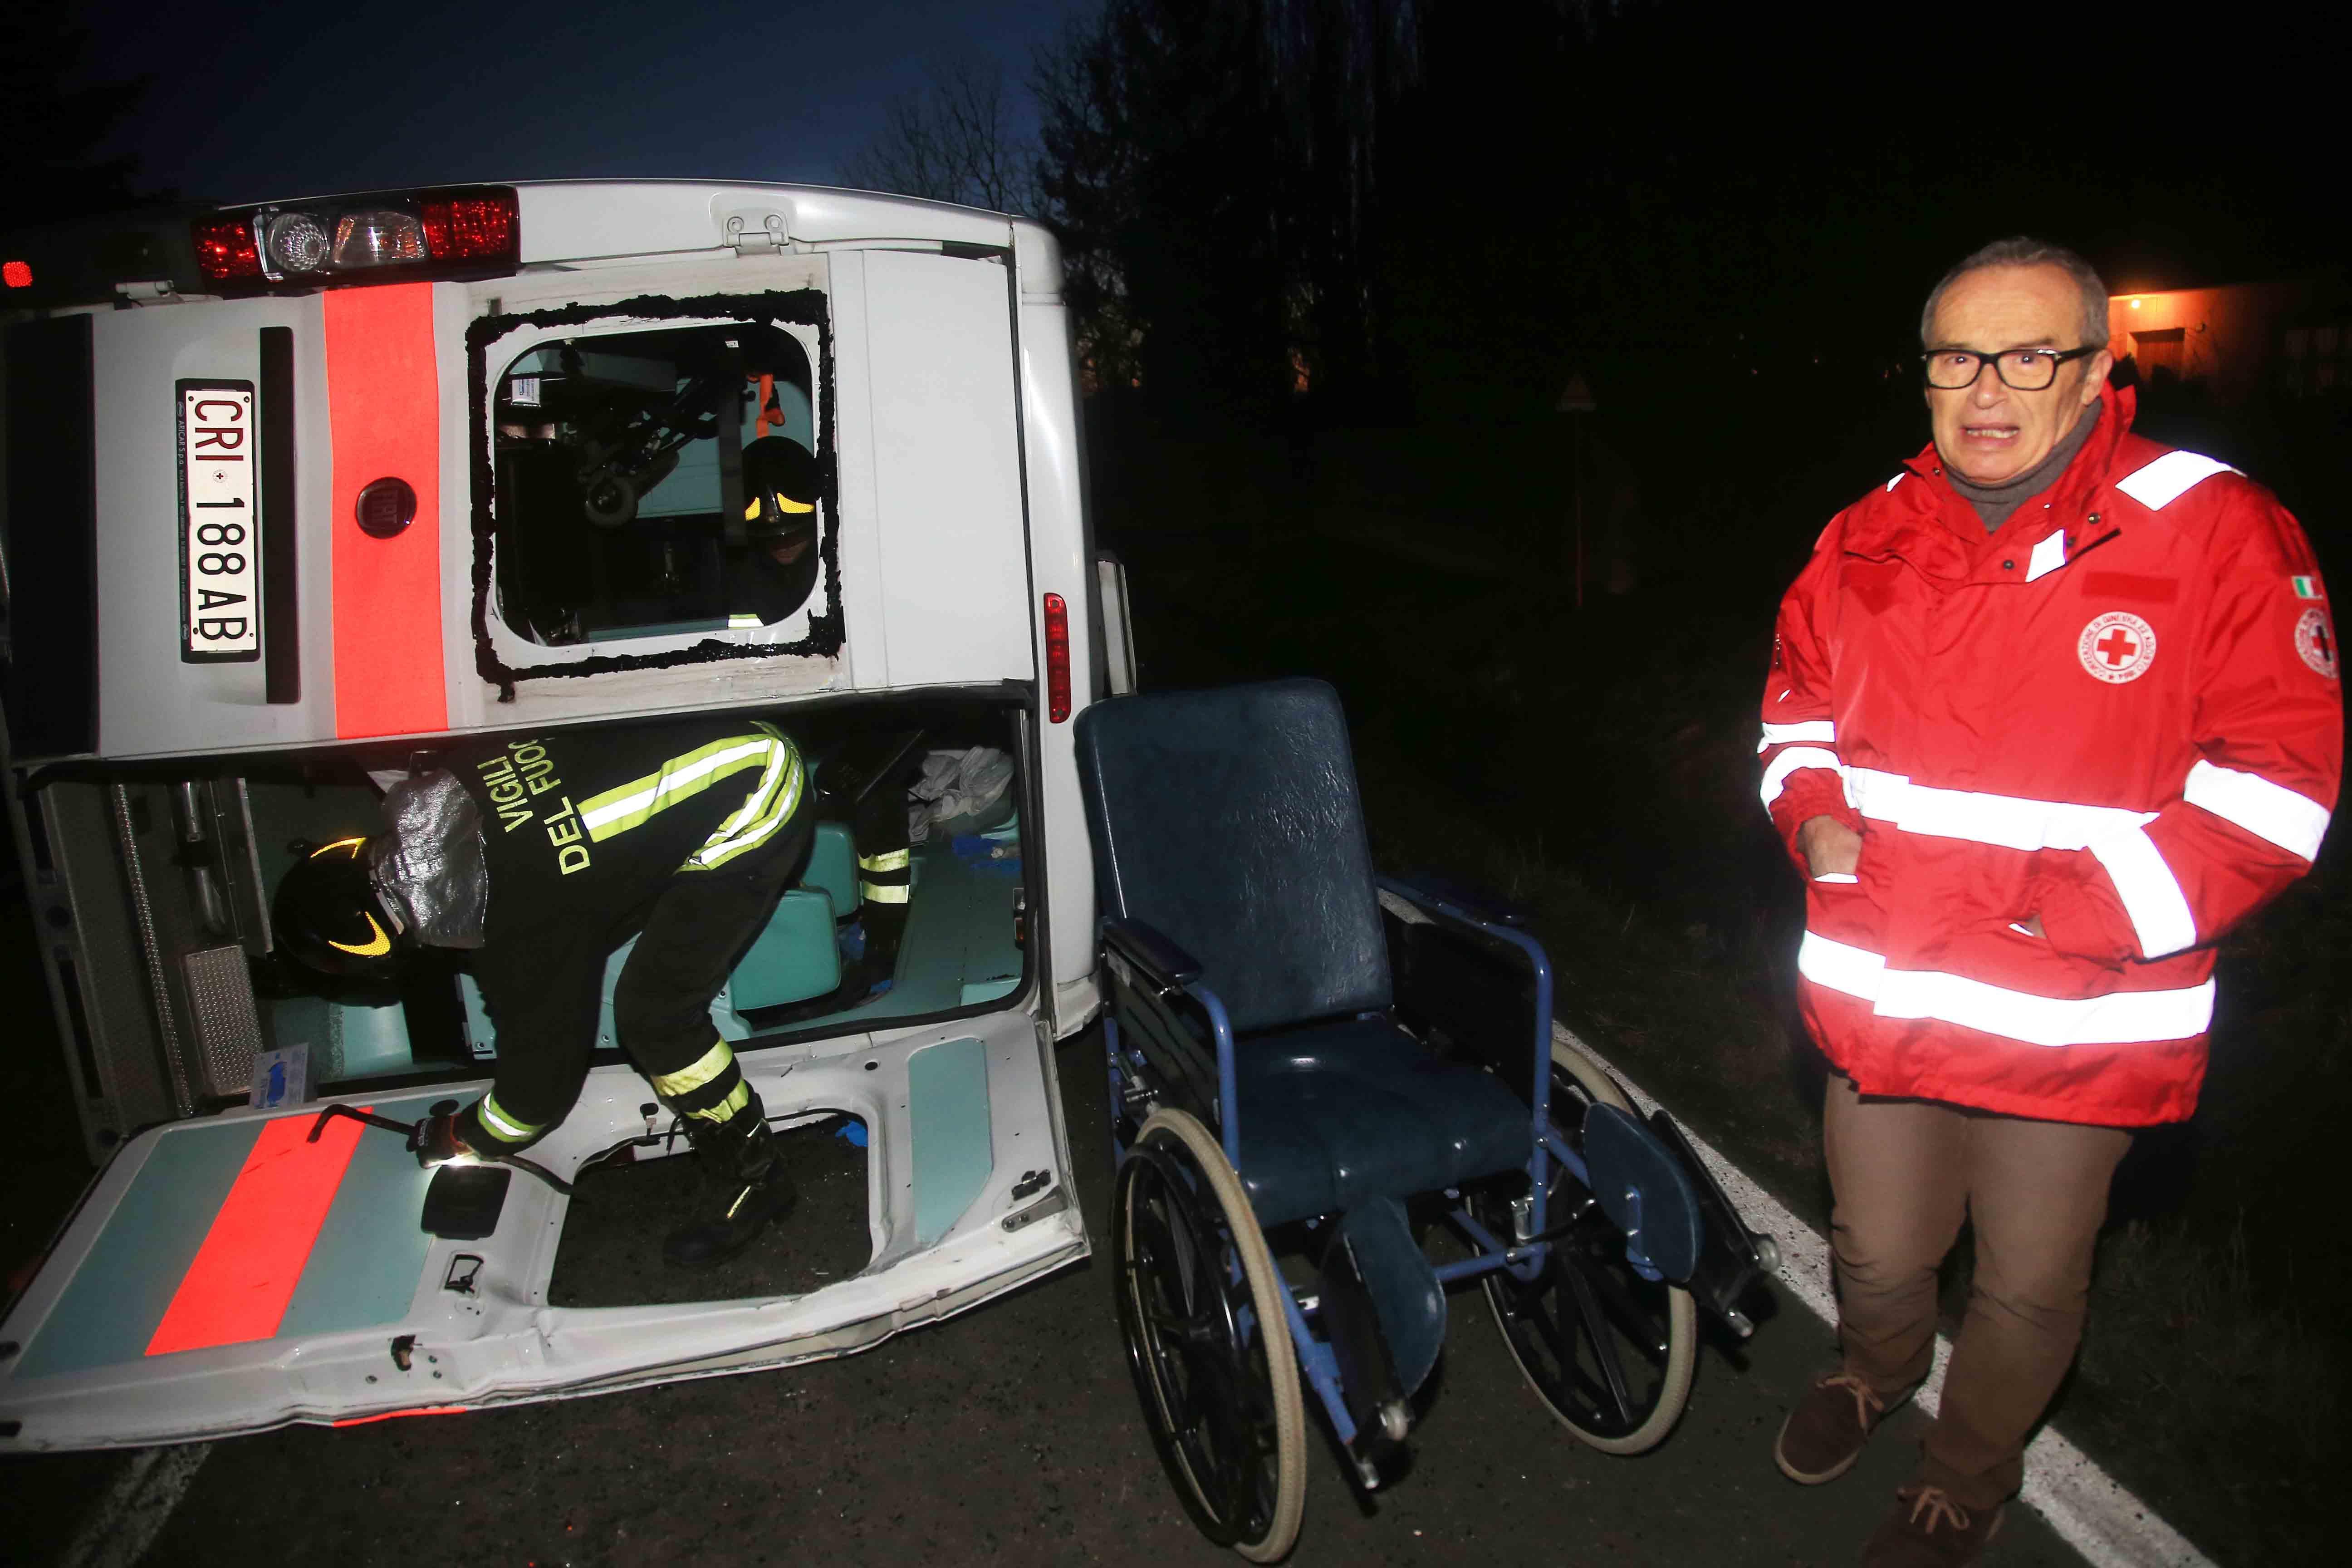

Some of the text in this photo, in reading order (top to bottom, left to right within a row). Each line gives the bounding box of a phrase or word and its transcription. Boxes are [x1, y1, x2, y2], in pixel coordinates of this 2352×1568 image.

[177, 420, 186, 446] ARICAR
[195, 400, 244, 461] CRI
[477, 755, 534, 833] VIGILI
[544, 795, 591, 875] DEL
